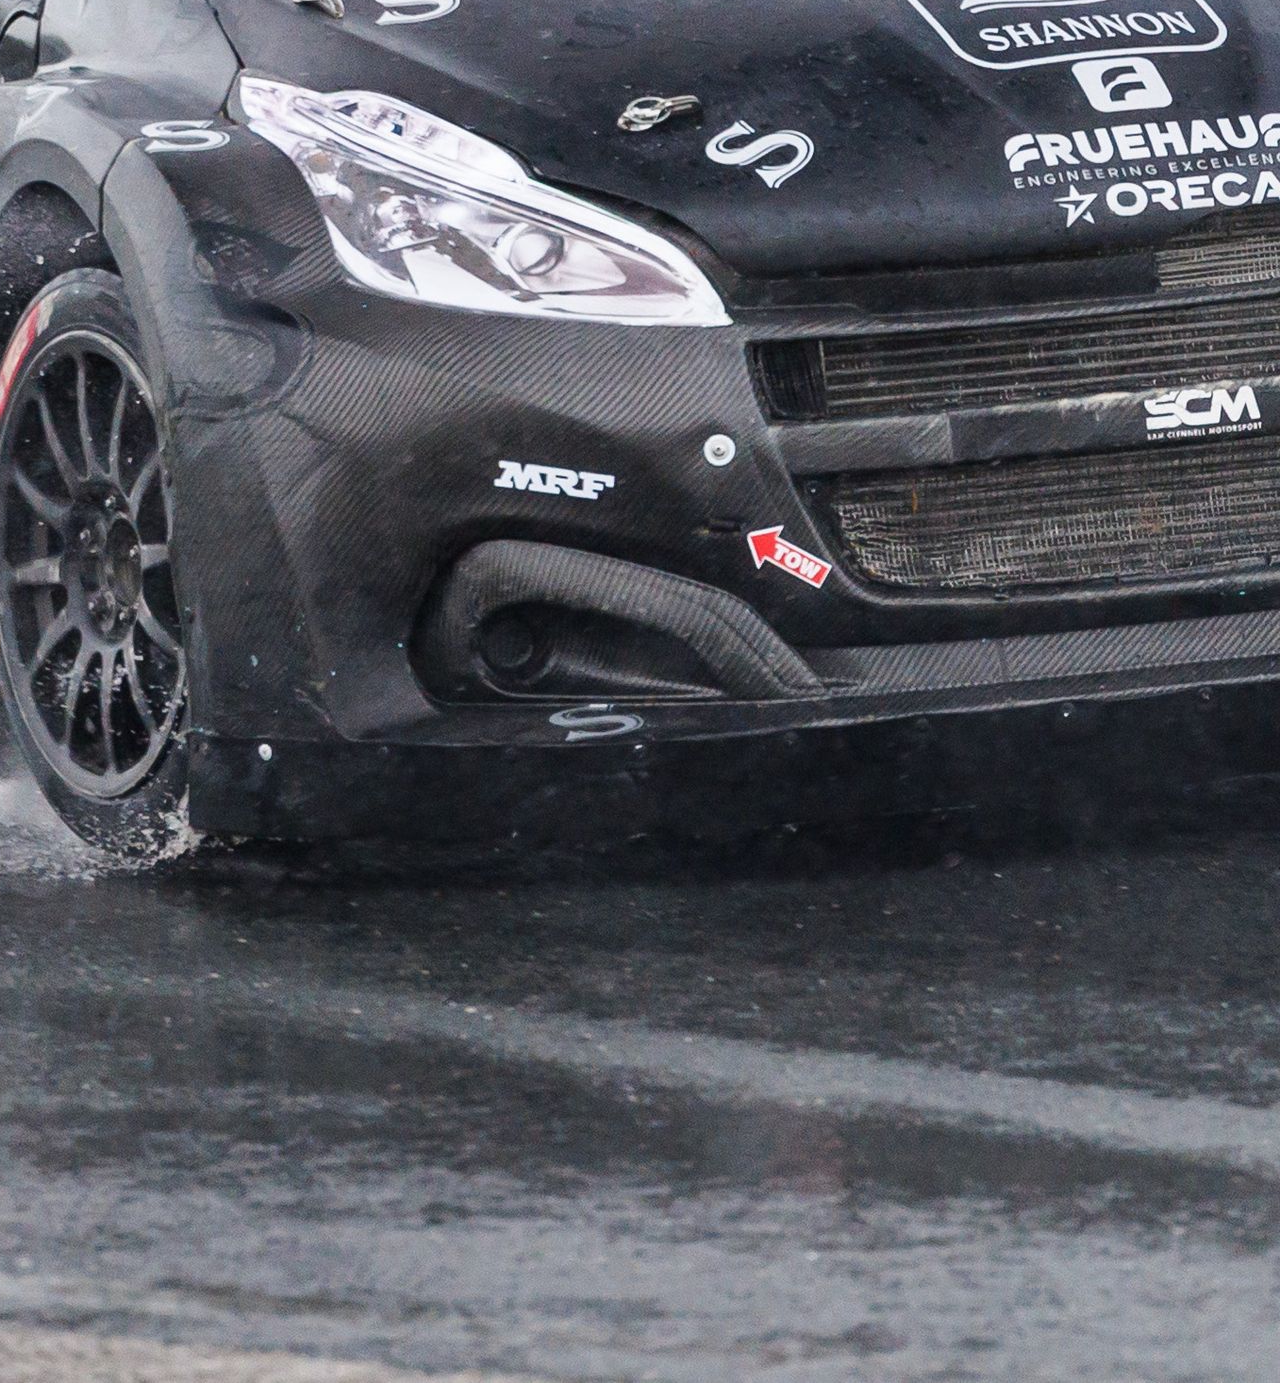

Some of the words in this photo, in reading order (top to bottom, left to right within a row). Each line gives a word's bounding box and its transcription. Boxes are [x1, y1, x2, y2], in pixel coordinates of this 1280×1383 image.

[979, 10, 1196, 54] SHANNON
[1013, 163, 1160, 189] ENGINEERING
[1143, 385, 1262, 431] SCM
[493, 460, 615, 500] MRF
[773, 543, 822, 579] TOW
